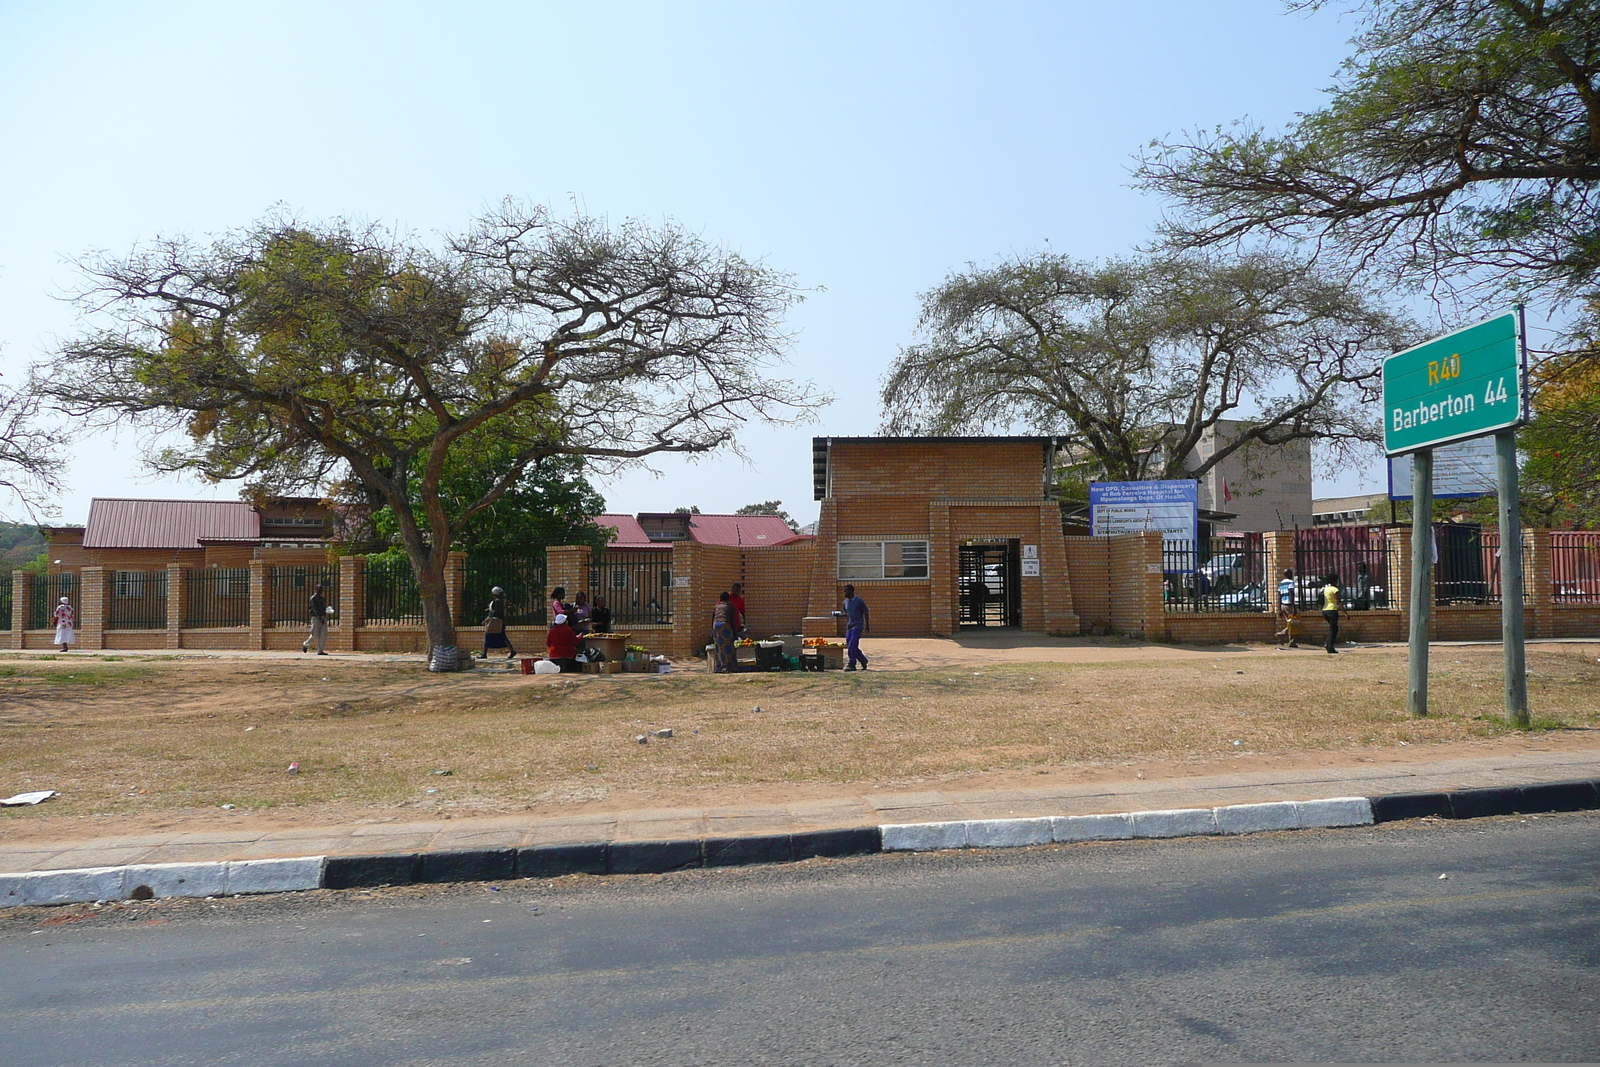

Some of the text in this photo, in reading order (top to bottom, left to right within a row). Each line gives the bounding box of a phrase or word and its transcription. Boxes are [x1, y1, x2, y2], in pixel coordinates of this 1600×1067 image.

[1428, 353, 1461, 386] R40
[1393, 377, 1507, 432] Barberton 44
